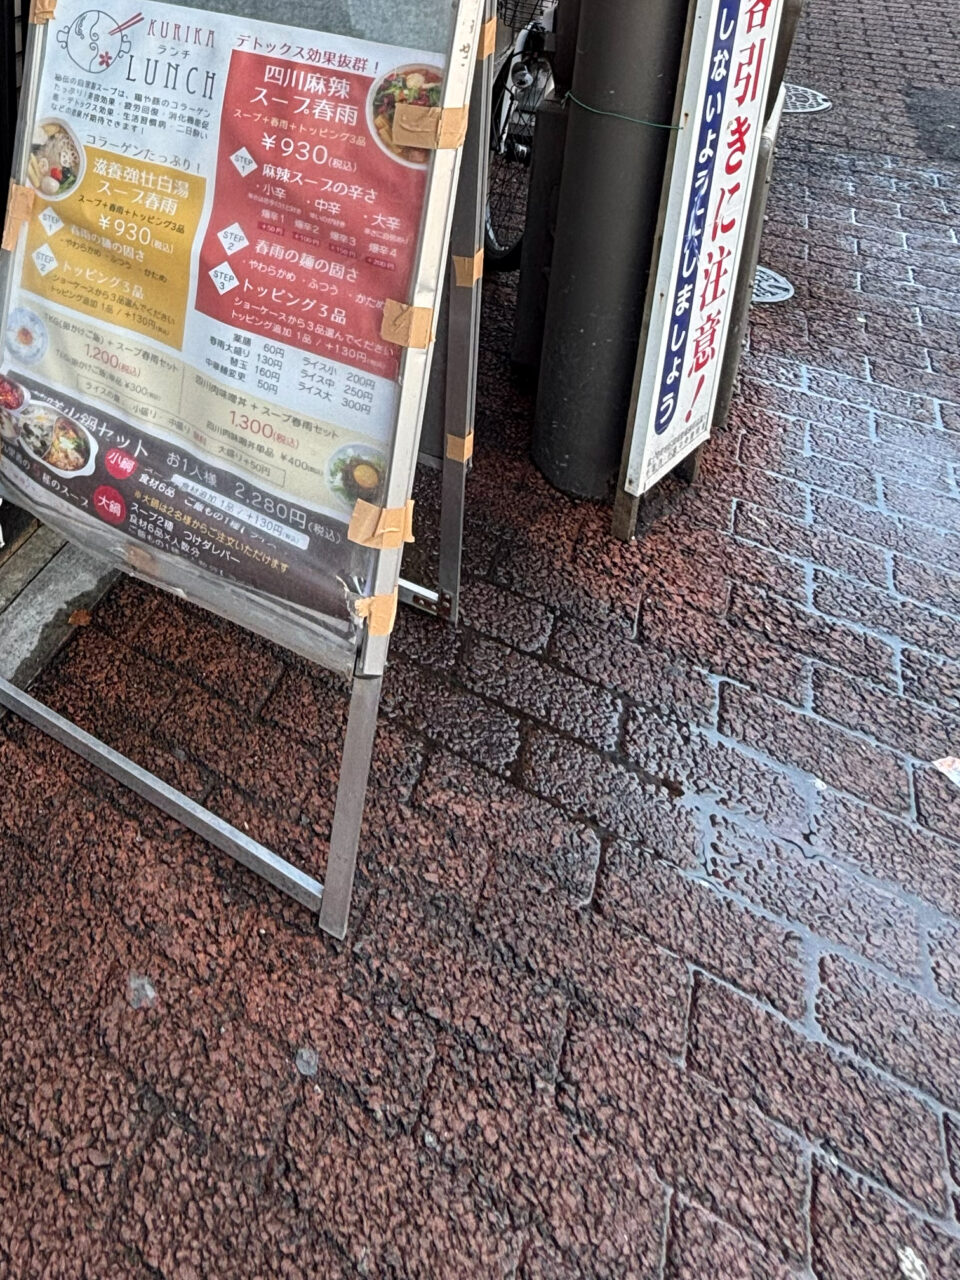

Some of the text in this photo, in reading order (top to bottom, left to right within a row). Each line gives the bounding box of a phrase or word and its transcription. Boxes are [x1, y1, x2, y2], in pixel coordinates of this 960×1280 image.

[147, 19, 216, 48] KURIKA
[157, 44, 191, 60] ランチ
[125, 55, 217, 100] LUNCH
[263, 65, 351, 99] 四川麻辣
[250, 86, 359, 127] スープ春雨
[234, 154, 254, 166] STEP
[93, 158, 190, 199] 滋養強壮白湯
[262, 163, 379, 204] 麻辣スープの辛さ
[96, 180, 179, 217] スープ春雨
[222, 231, 245, 242] STEP
[227, 243, 234, 251] 2
[35, 251, 55, 262] STEP
[255, 238, 359, 283] 春雨の麺の固さ
[212, 270, 235, 283] STEP
[218, 281, 225, 290] 3
[242, 277, 347, 325] トッピング3品
[231, 309, 292, 338] トッピング追加
[234, 296, 394, 356] ショーケースから3品選んでください
[256, 353, 283, 370] 130円
[263, 343, 285, 359] 60円
[255, 365, 281, 383] 160円
[257, 379, 279, 395] 50円
[300, 369, 374, 403] ライス中 250円
[302, 356, 376, 390] ライス小 200円
[298, 382, 372, 416] ライス大 300円
[108, 451, 136, 473] 小鍋
[166, 451, 218, 487] お1人様
[98, 495, 122, 518] 大鍋
